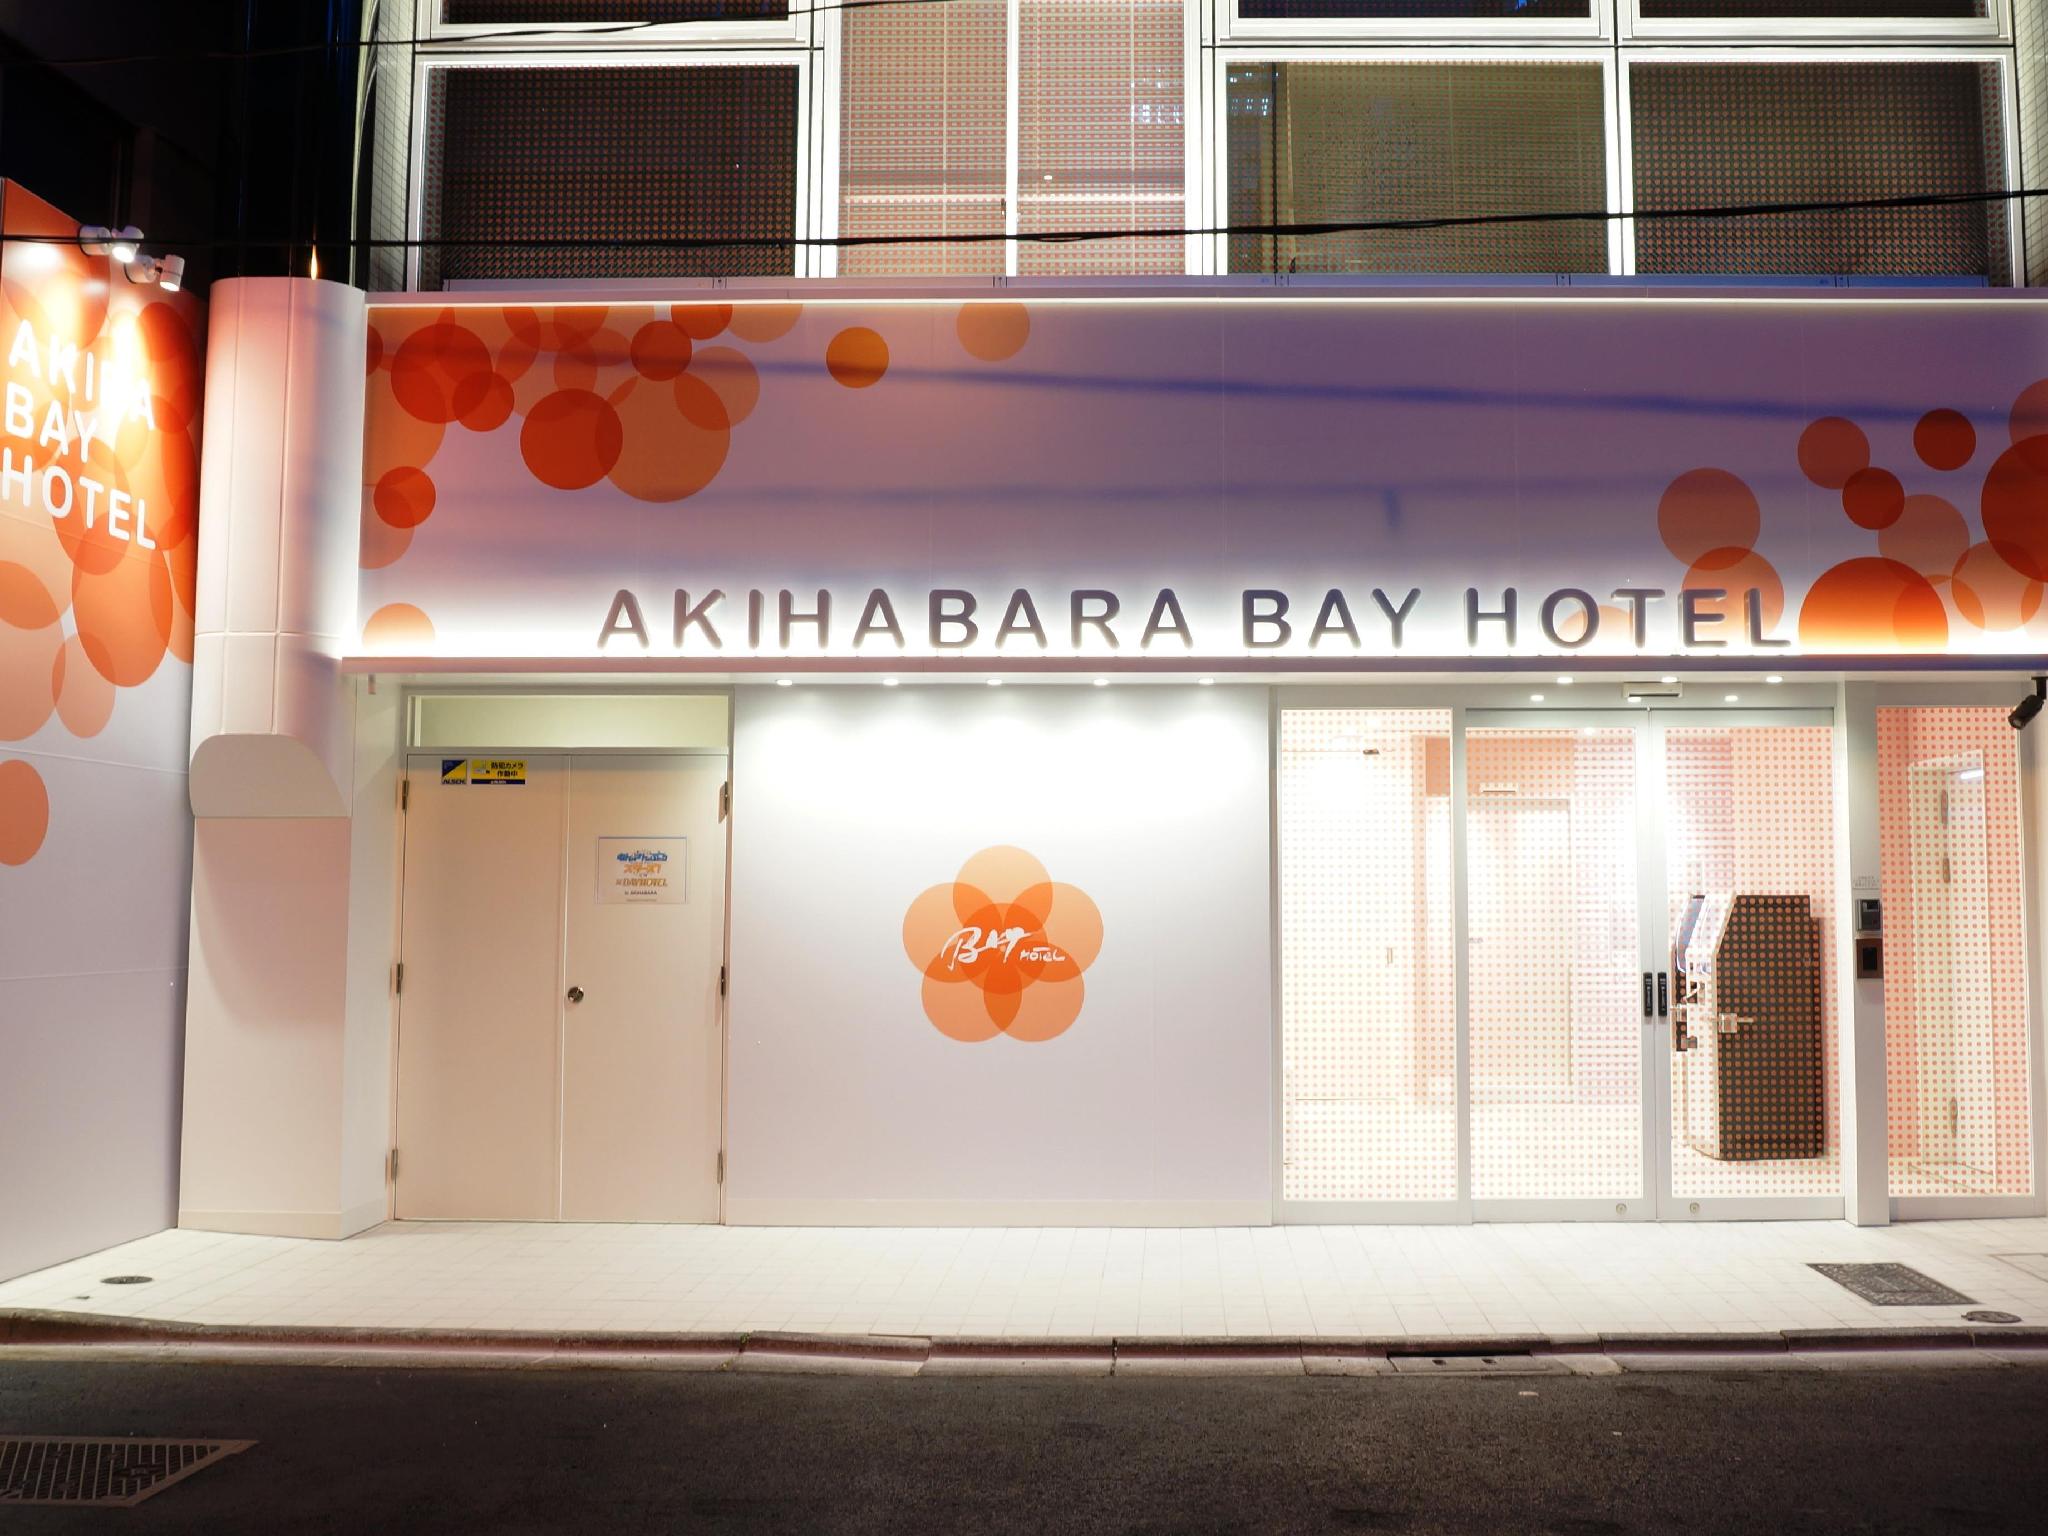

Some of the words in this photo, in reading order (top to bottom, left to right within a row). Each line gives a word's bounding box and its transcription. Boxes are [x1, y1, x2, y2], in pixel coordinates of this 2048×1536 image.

[5, 381, 98, 463] BAY
[1, 447, 156, 550] HOTEL
[597, 588, 1194, 650] AKIHABARA
[1241, 588, 1422, 650] BAY
[1463, 587, 1792, 650] HOTEL
